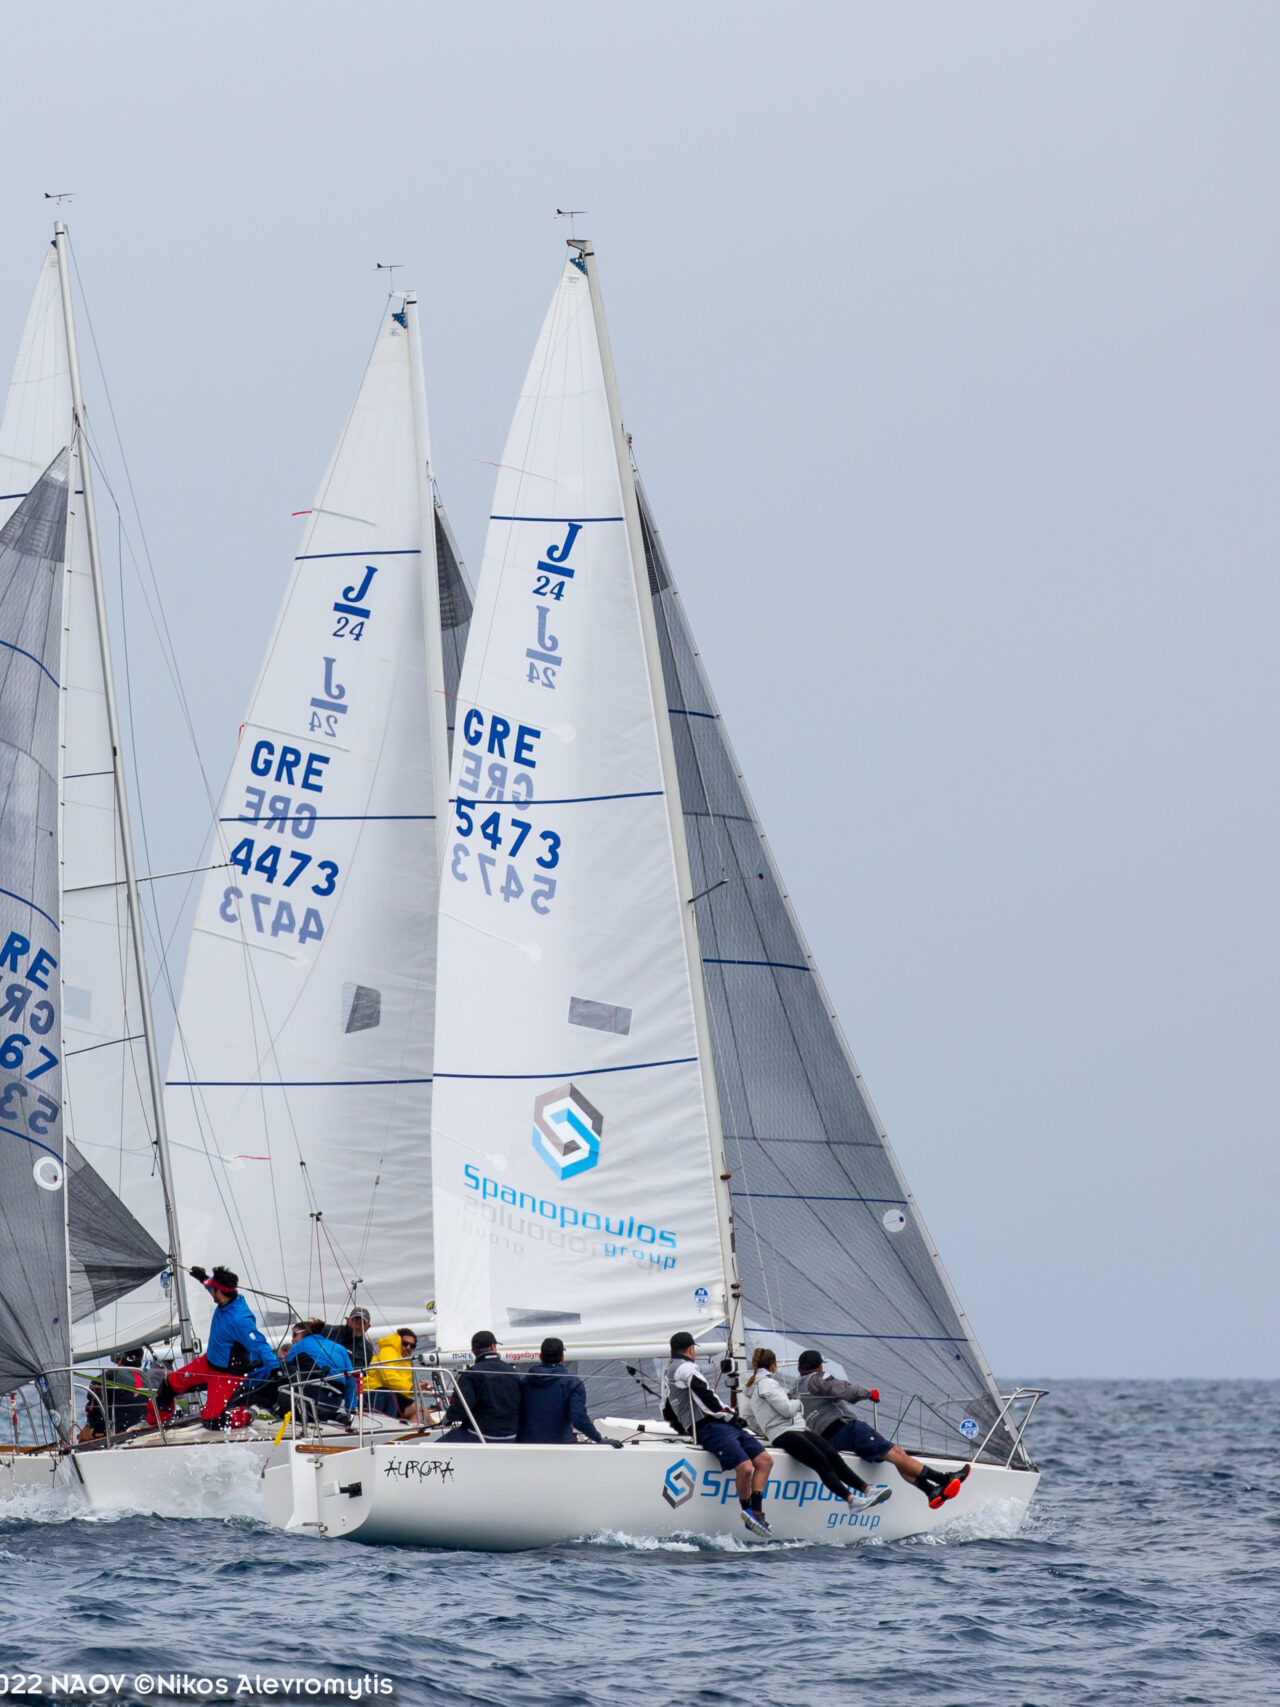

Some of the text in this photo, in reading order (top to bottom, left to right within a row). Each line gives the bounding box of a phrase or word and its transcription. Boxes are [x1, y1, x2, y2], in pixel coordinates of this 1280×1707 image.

[546, 522, 583, 563] J
[342, 565, 378, 603] J
[532, 575, 565, 601] 24
[332, 616, 366, 641] 24
[464, 708, 541, 769] GRE
[250, 740, 330, 793] GRE
[455, 797, 562, 870] 5473
[229, 837, 339, 897] 4473
[464, 1163, 677, 1249] Spanopoulos
[604, 1242, 677, 1270] group
[384, 1456, 455, 1484] AURORA
[826, 1512, 882, 1530] group
